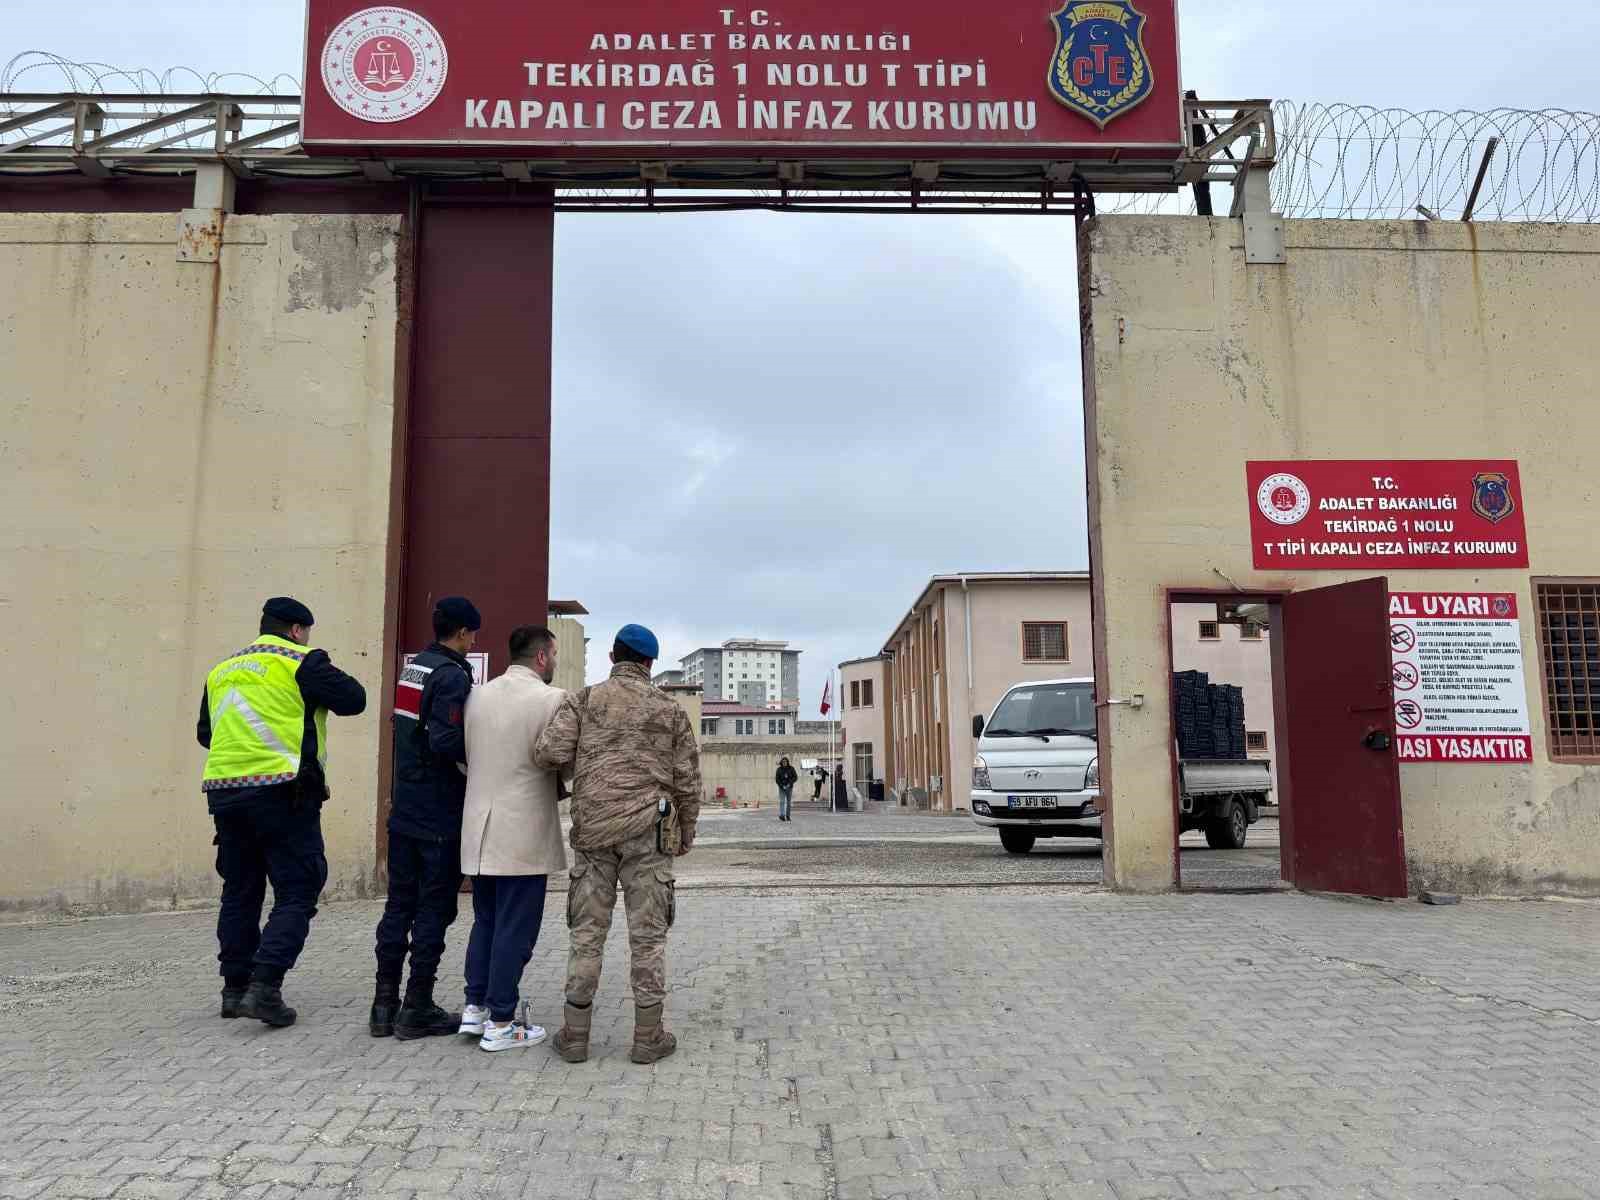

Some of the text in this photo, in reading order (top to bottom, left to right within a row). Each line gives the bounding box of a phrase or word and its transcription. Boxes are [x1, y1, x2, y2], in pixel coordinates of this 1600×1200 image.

[719, 9, 782, 26] T.C.
[590, 31, 912, 51] ADALET BAKANLIĞI
[523, 58, 987, 87] TEKİRDAĞ 1 NOLU T TİPİ
[465, 93, 1038, 130] KAPALI CEZA İNFAZ KURUMU
[1372, 476, 1399, 490] T.C.
[1319, 497, 1374, 510] ADALET
[1378, 494, 1457, 510] BAKANLIĞI
[1323, 516, 1454, 533] TEKİRDAĞ 1 NOLU
[1264, 537, 1517, 555] T TİPİ KAPALI CEZA İNFAZ KURUMU
[1422, 595, 1490, 615] UYARI
[1436, 738, 1528, 759] YASAKTIR
